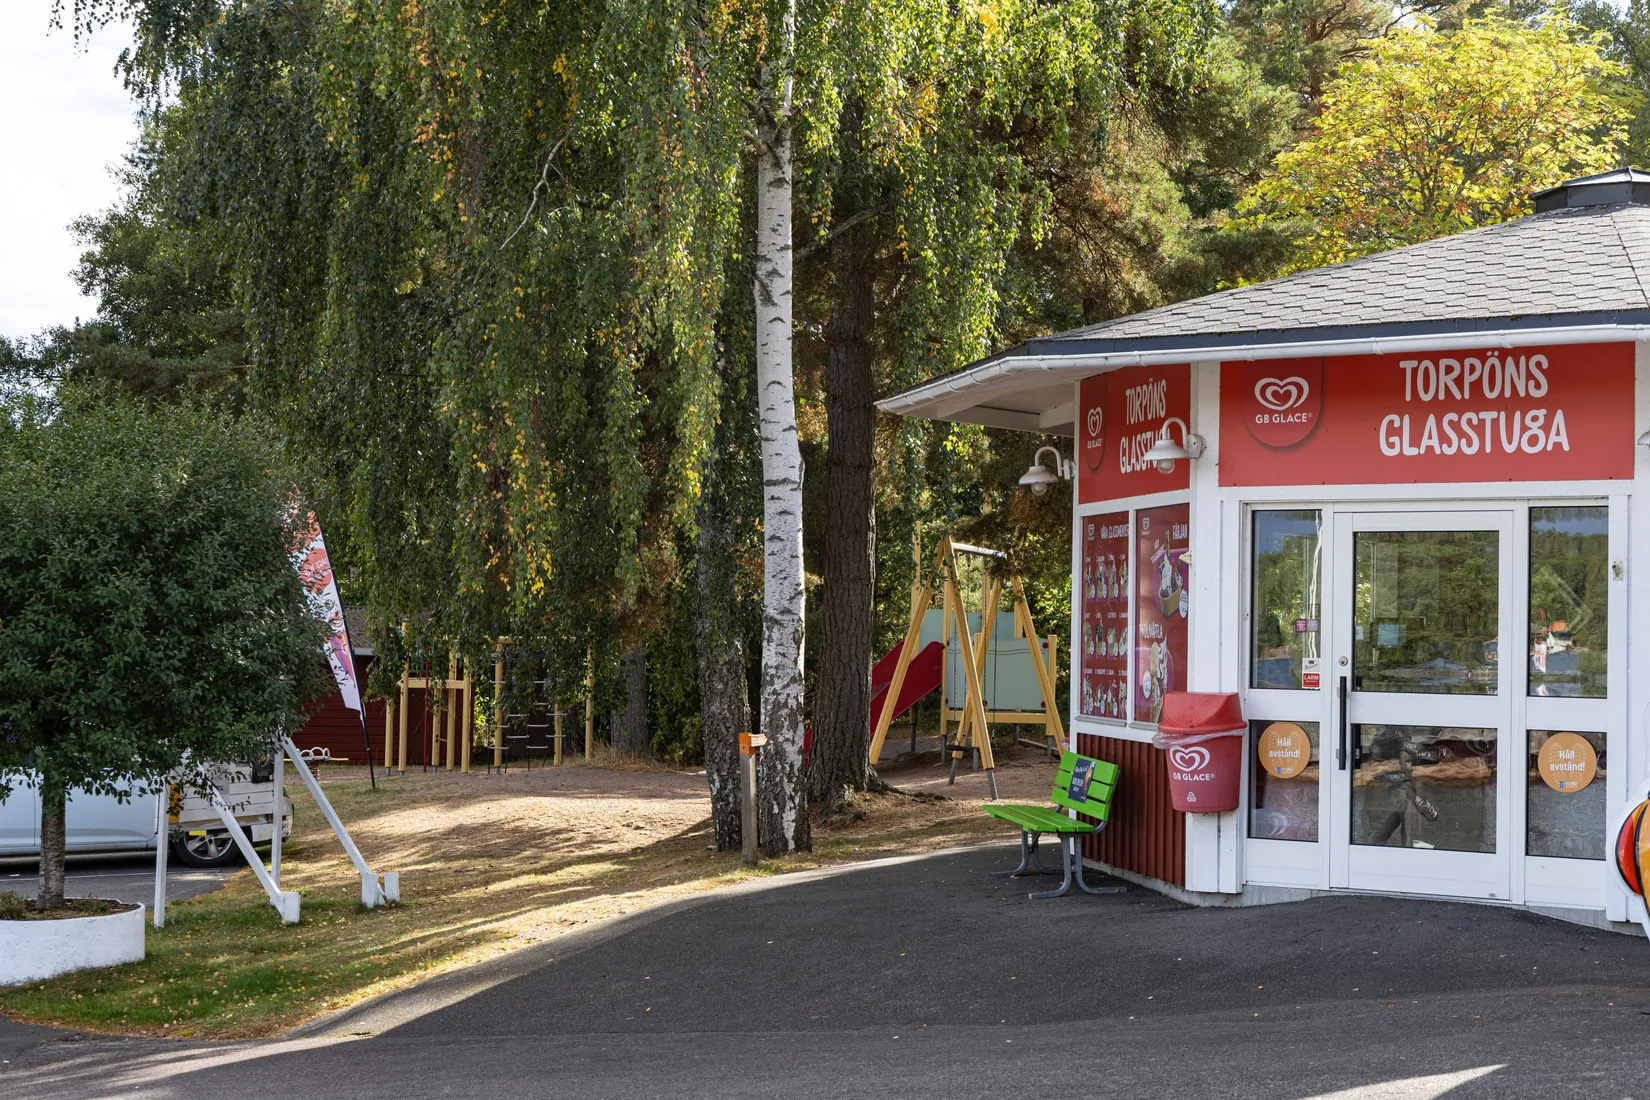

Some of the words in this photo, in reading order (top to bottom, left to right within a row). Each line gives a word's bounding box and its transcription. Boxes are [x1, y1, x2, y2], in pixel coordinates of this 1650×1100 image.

[1399, 351, 1549, 401] TORPÖNS
[1125, 377, 1167, 425] TORPÖNS
[1255, 414, 1269, 424] GB
[1277, 737, 1292, 747] Håll
[1268, 749, 1301, 758] avstånd!
[1559, 749, 1575, 759] Håll
[1549, 761, 1586, 771] avstånd!
[1172, 772, 1182, 780] GB
